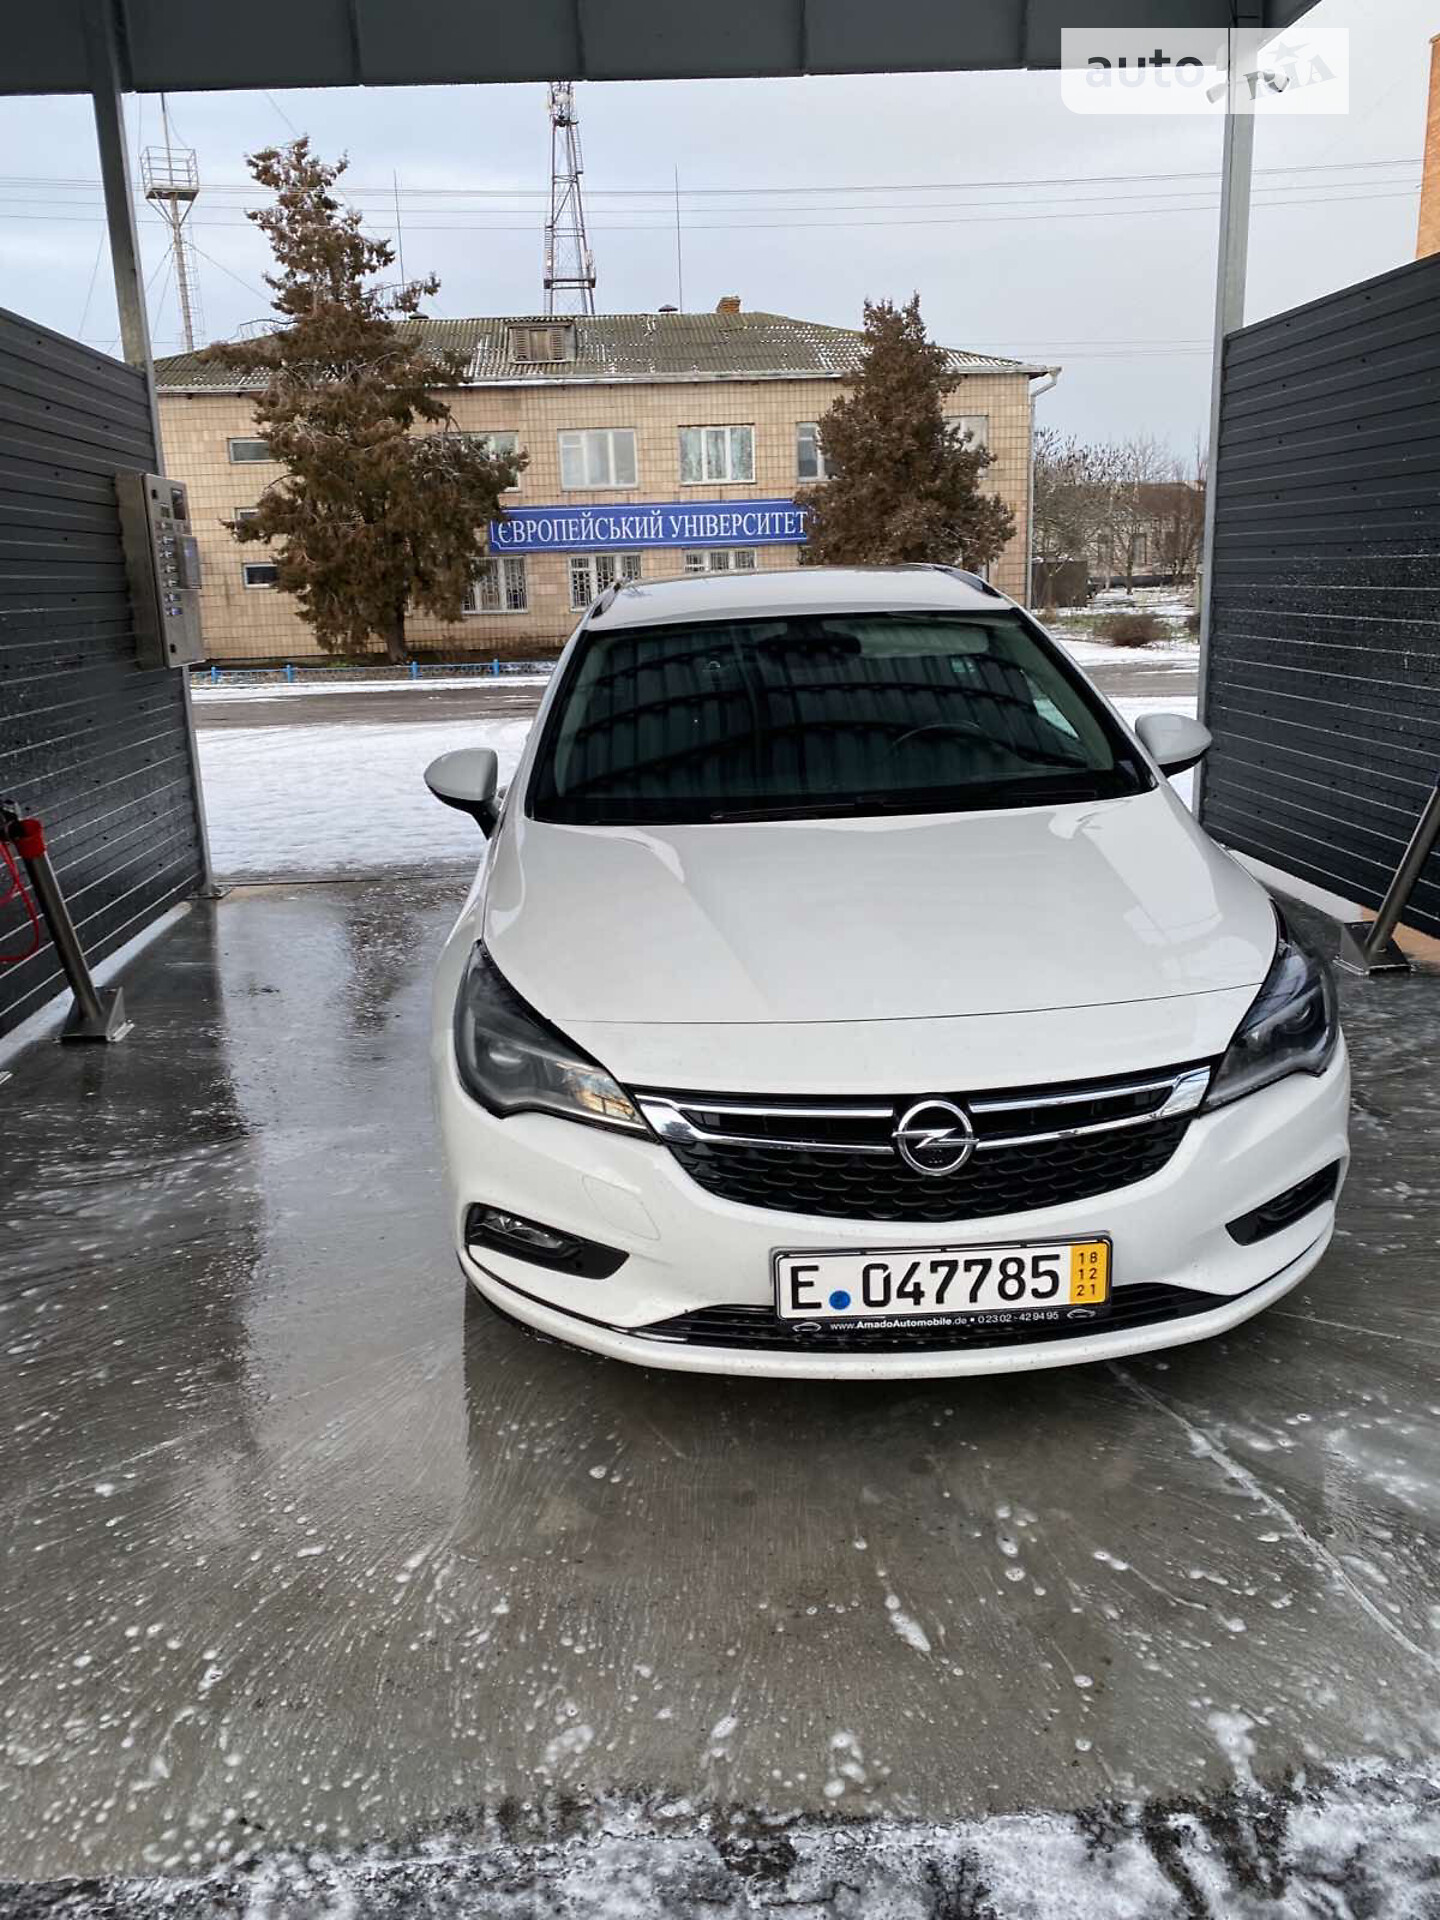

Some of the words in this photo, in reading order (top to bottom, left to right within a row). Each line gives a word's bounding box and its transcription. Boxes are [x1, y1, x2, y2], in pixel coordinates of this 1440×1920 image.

[498, 510, 664, 543] ЄВРОПЕЙСЬКИЙ
[671, 511, 808, 538] УНІВЕРСИТЕТ
[1079, 1252, 1098, 1264] 18
[1079, 1267, 1097, 1280] 12
[791, 1265, 822, 1310] E
[862, 1254, 1060, 1308] 047785
[1076, 1284, 1095, 1296] 21
[830, 1316, 967, 1330] www.AmadoAutomobile.de
